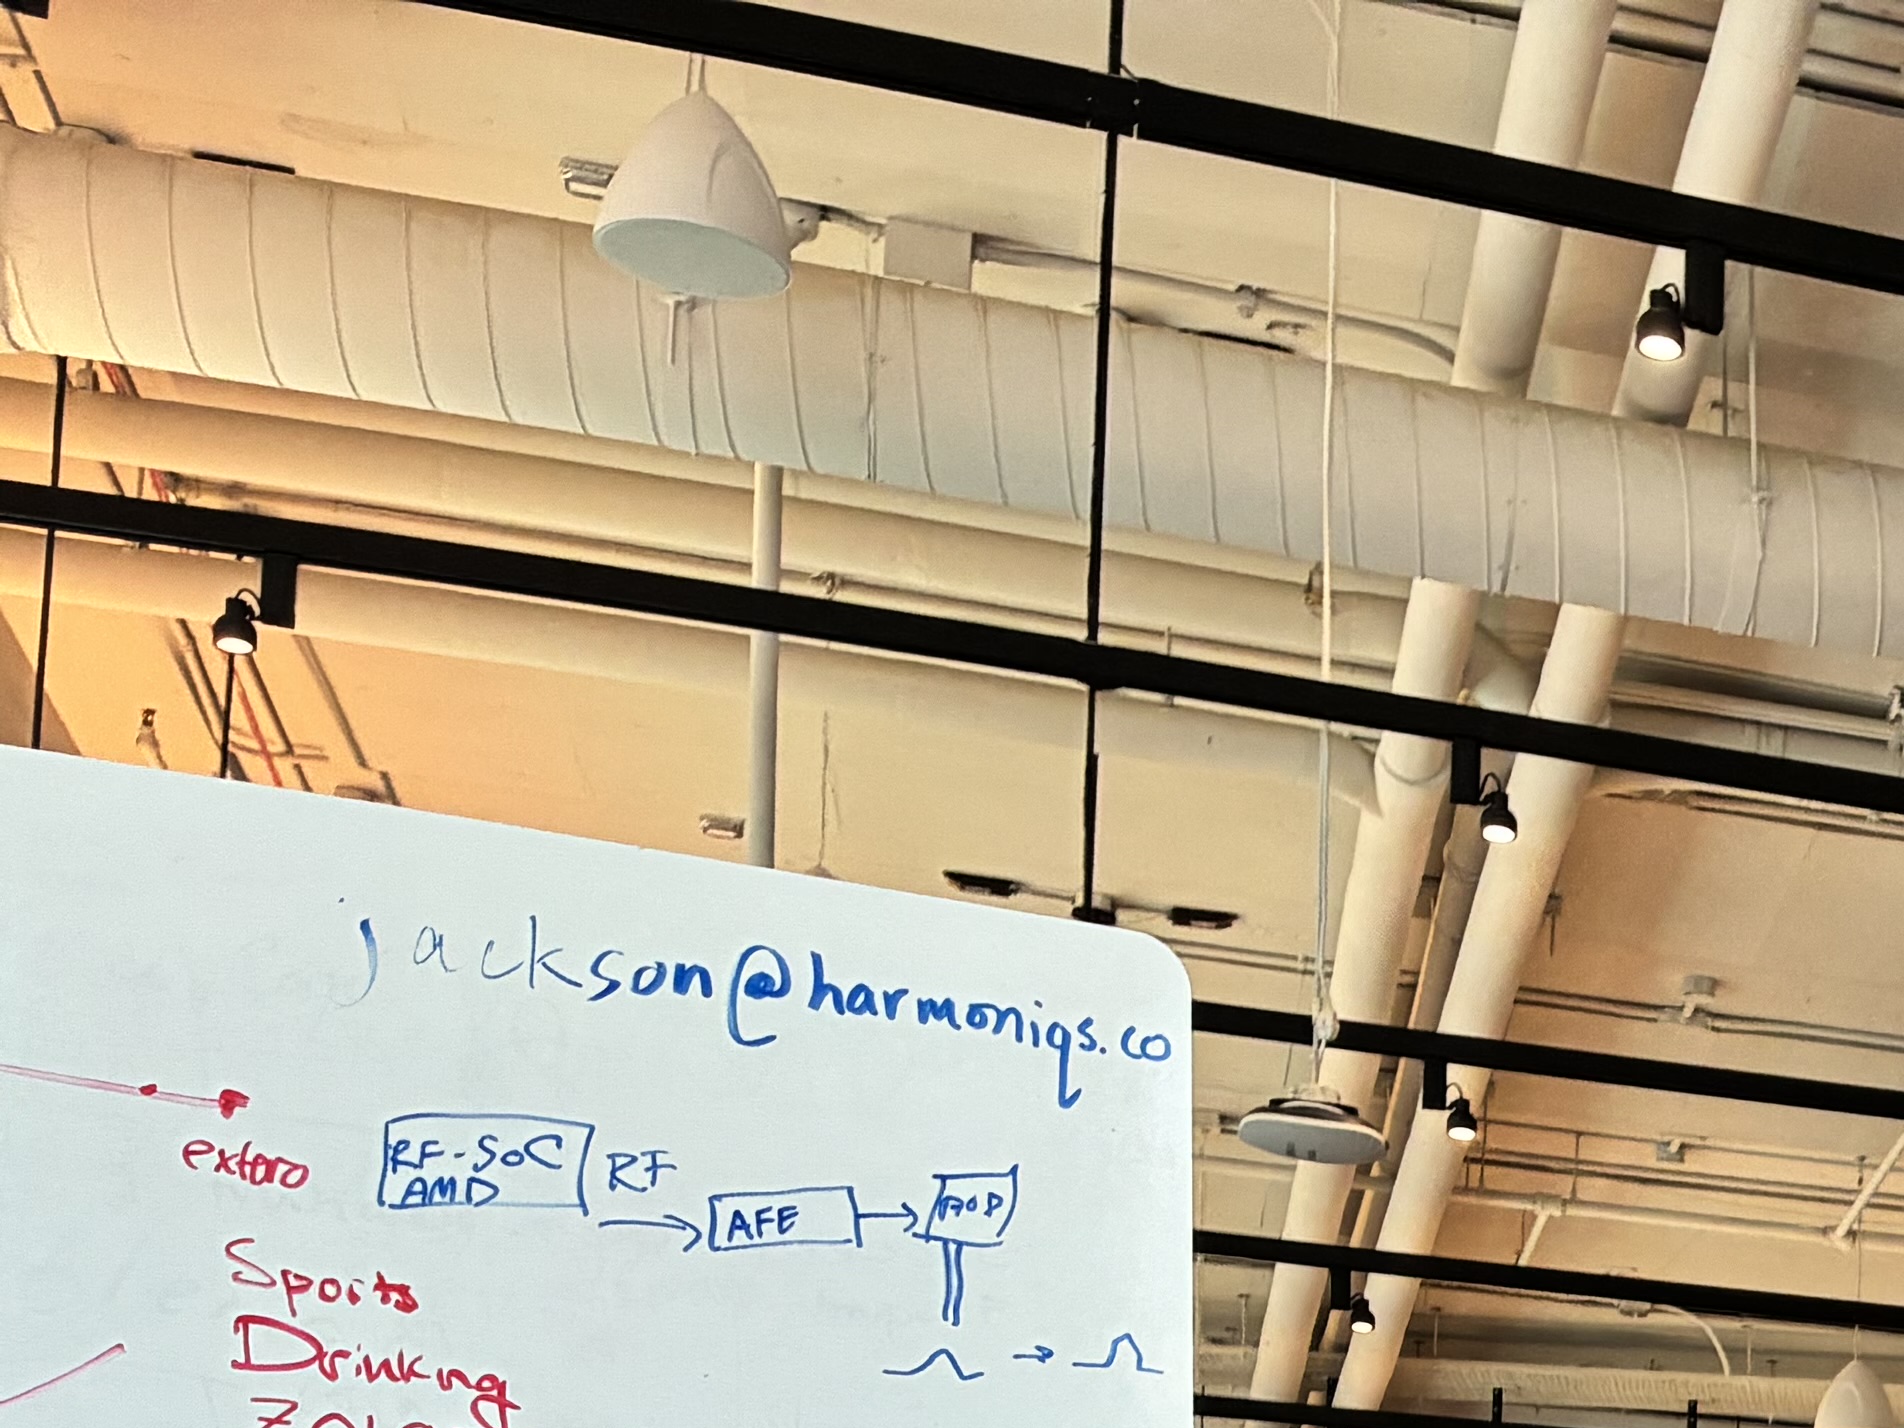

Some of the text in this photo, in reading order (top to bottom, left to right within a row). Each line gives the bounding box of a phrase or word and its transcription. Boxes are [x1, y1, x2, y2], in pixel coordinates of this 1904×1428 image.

[335, 897, 1172, 1107] jackson@harmoniqs.co
[402, 1177, 500, 1206] AMD
[606, 1151, 677, 1192] RF
[726, 1204, 800, 1245] AFE
[224, 1238, 419, 1316] Sports
